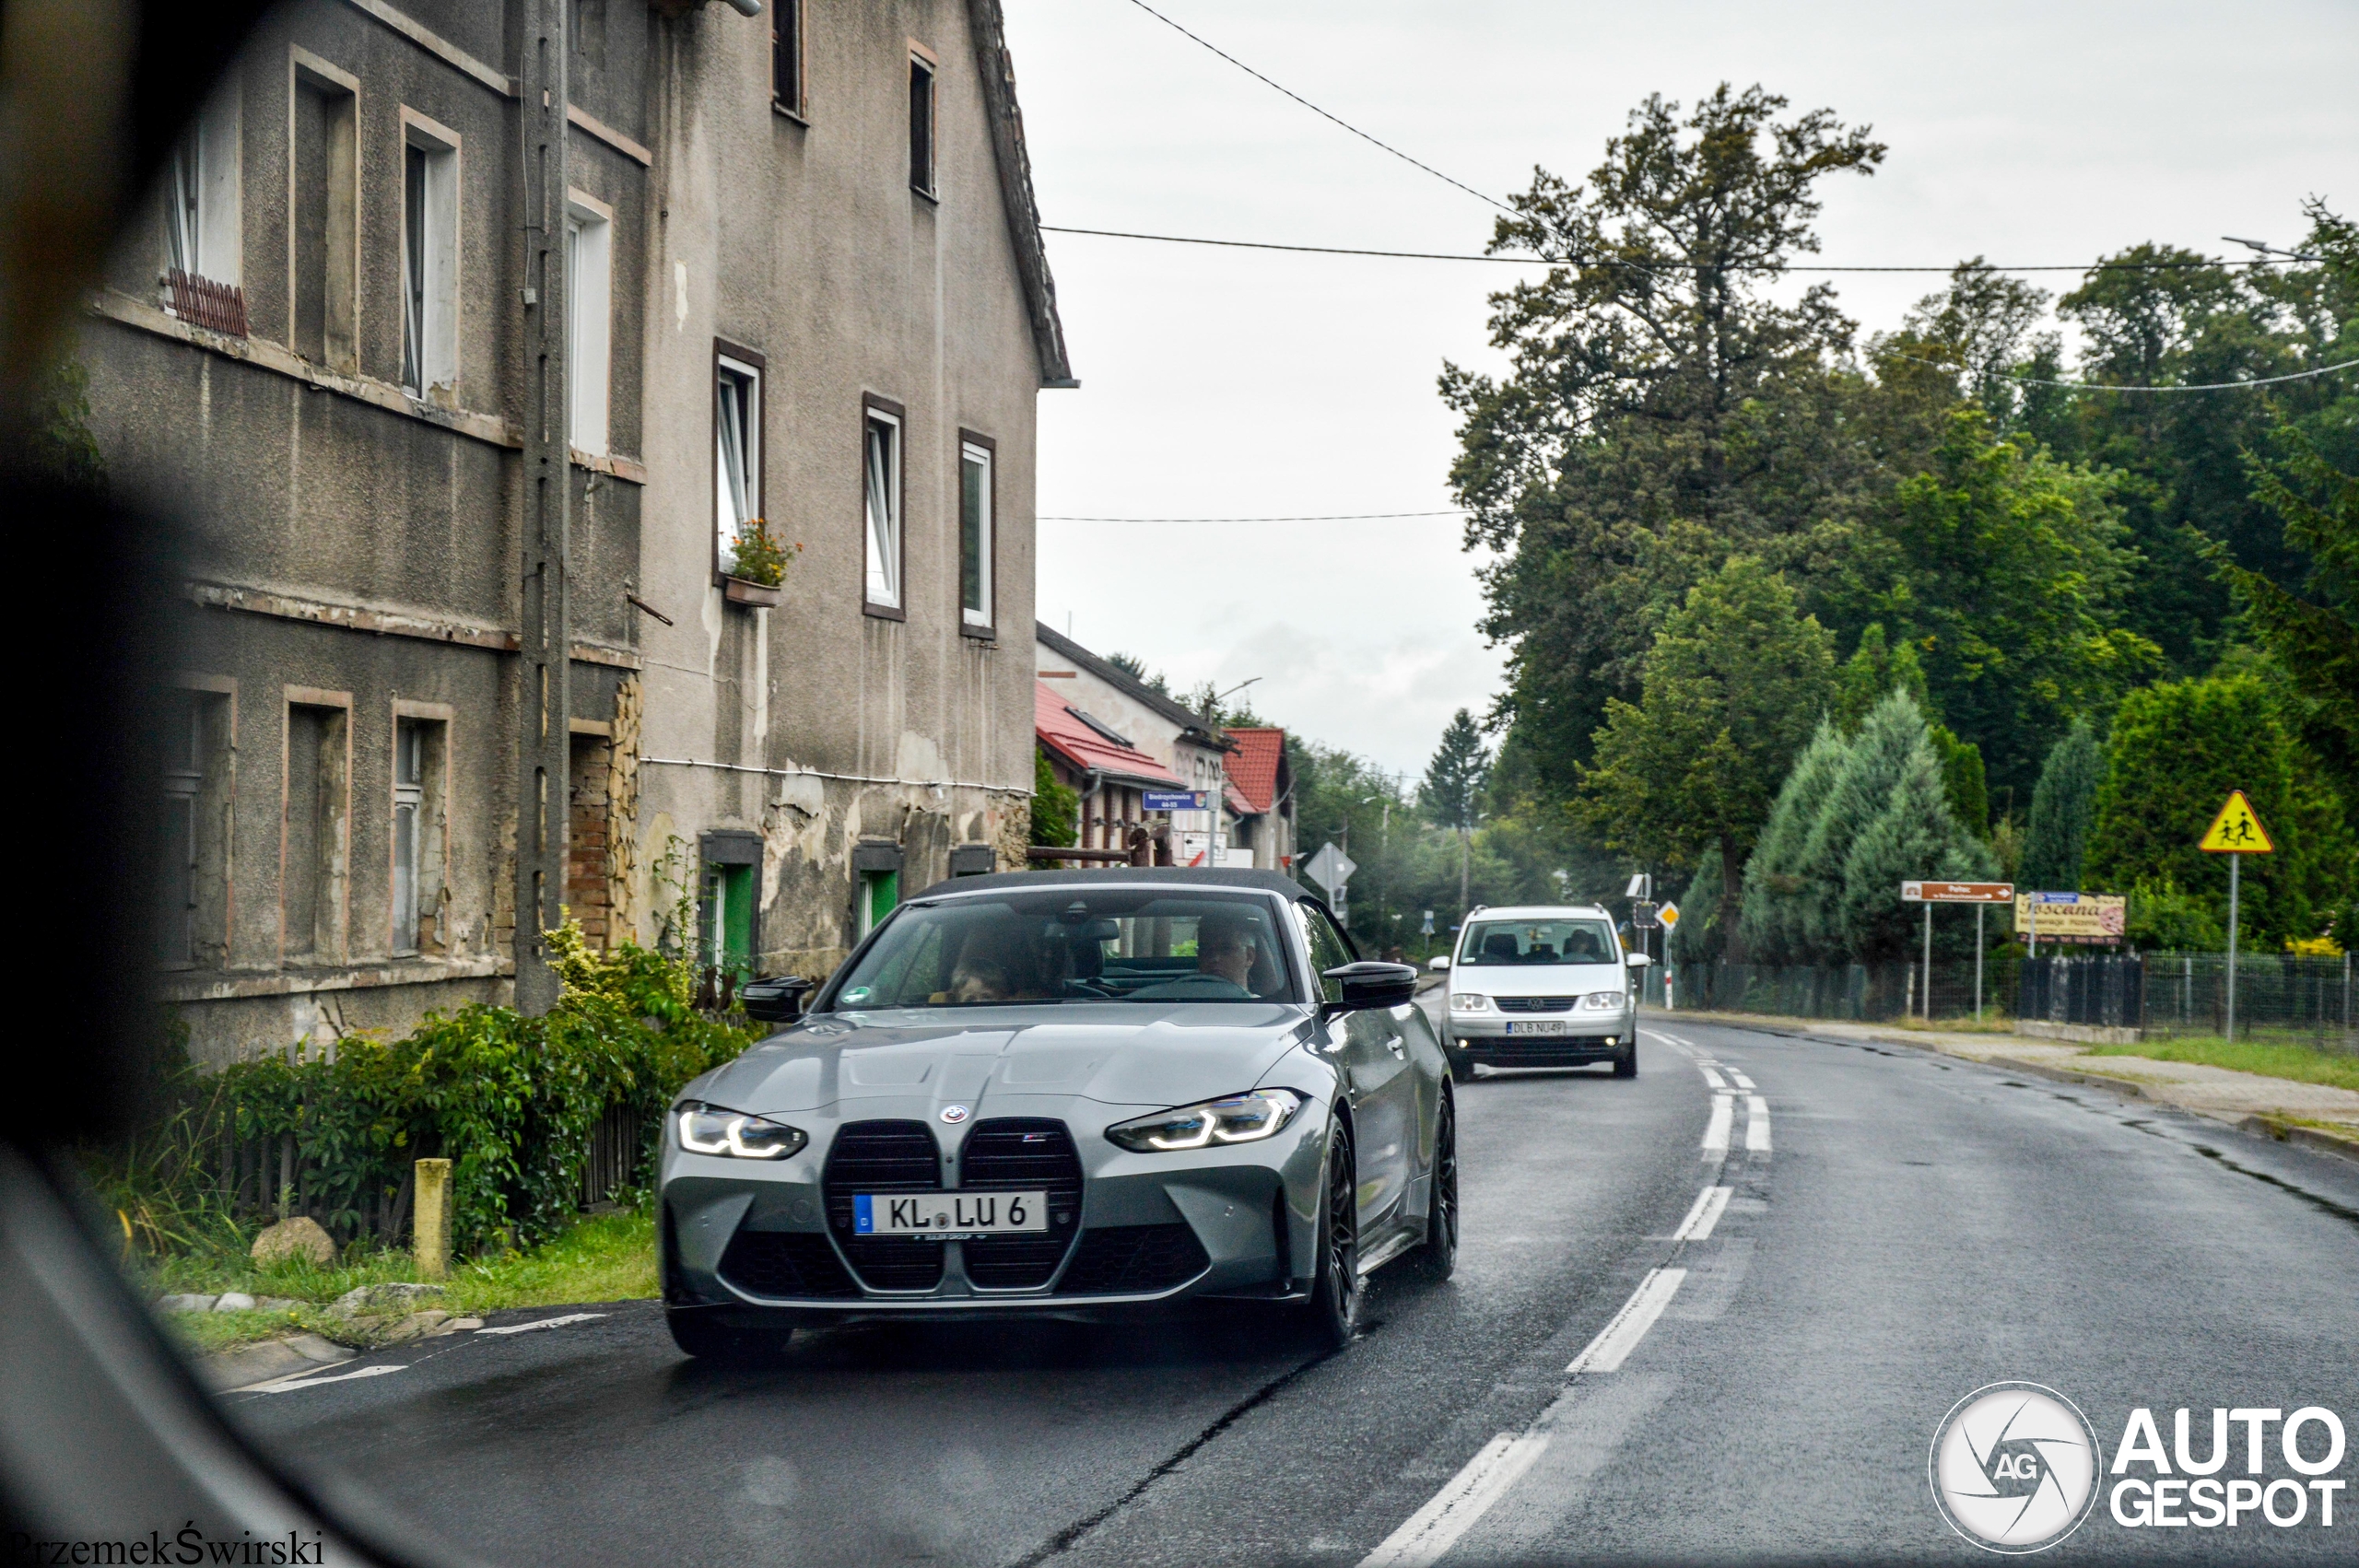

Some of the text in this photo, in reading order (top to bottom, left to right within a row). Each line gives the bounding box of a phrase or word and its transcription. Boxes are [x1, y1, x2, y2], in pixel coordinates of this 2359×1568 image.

[1514, 1023, 1533, 1033] DLB
[890, 1196, 1027, 1228] KL LU 6
